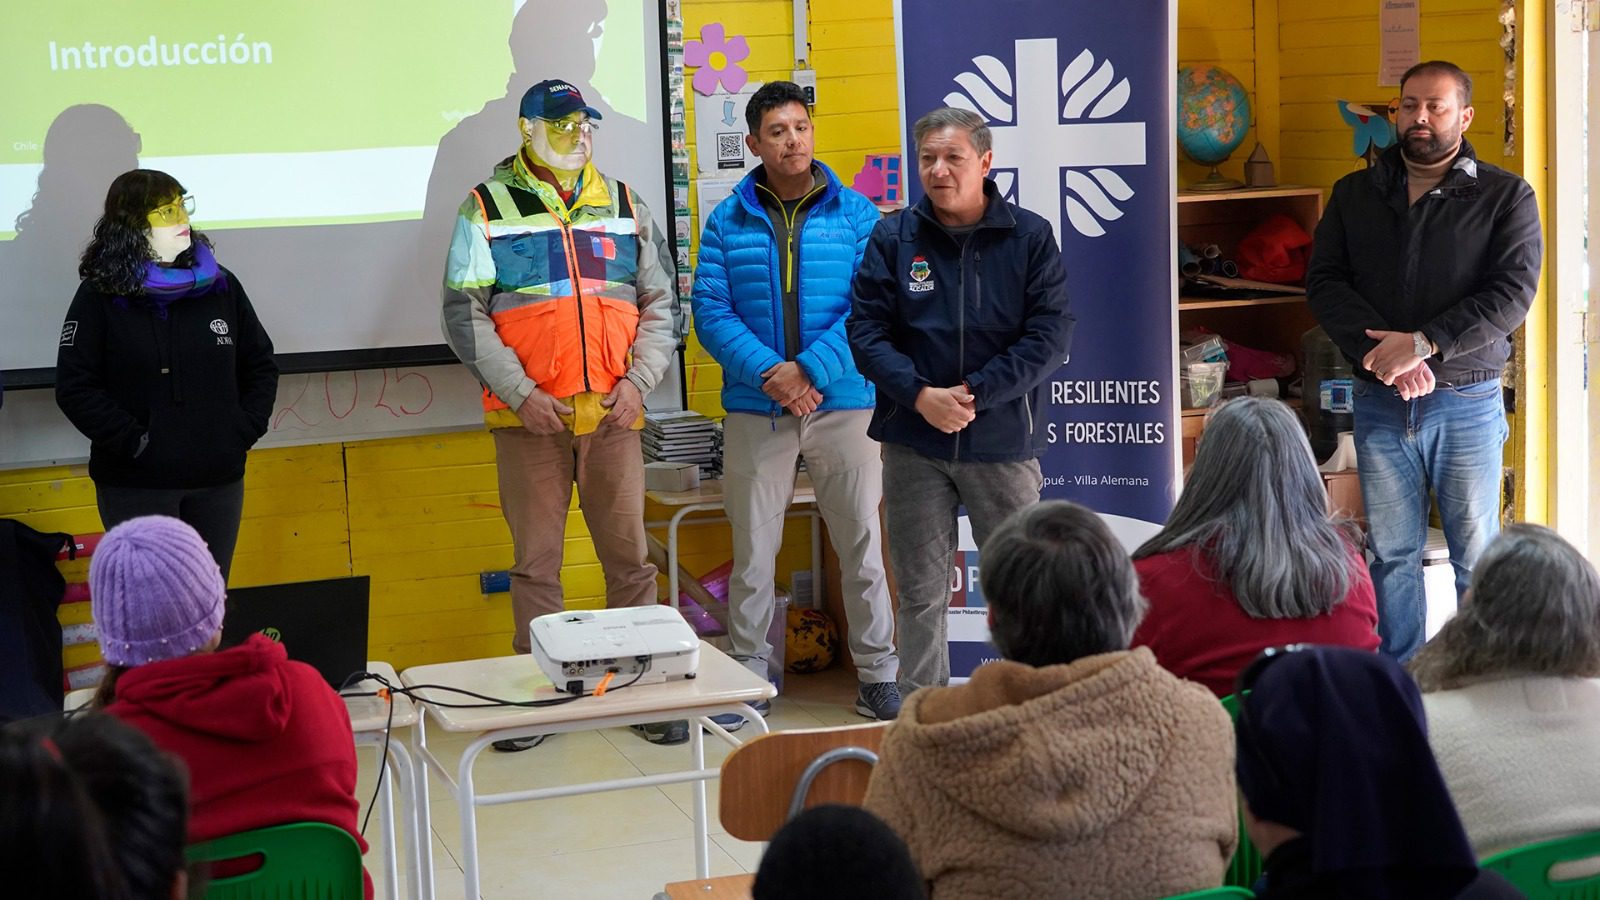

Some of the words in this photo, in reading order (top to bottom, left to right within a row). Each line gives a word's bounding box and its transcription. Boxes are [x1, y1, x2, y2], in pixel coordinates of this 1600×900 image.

[49, 33, 273, 71] Introducción
[13, 140, 38, 151] Chile
[1051, 380, 1161, 405] RESILIENTES
[1065, 422, 1165, 444] FORESTALES
[1074, 475, 1098, 486] Villa
[1100, 475, 1149, 486] Alemana
[962, 608, 988, 617] Philanthropy
